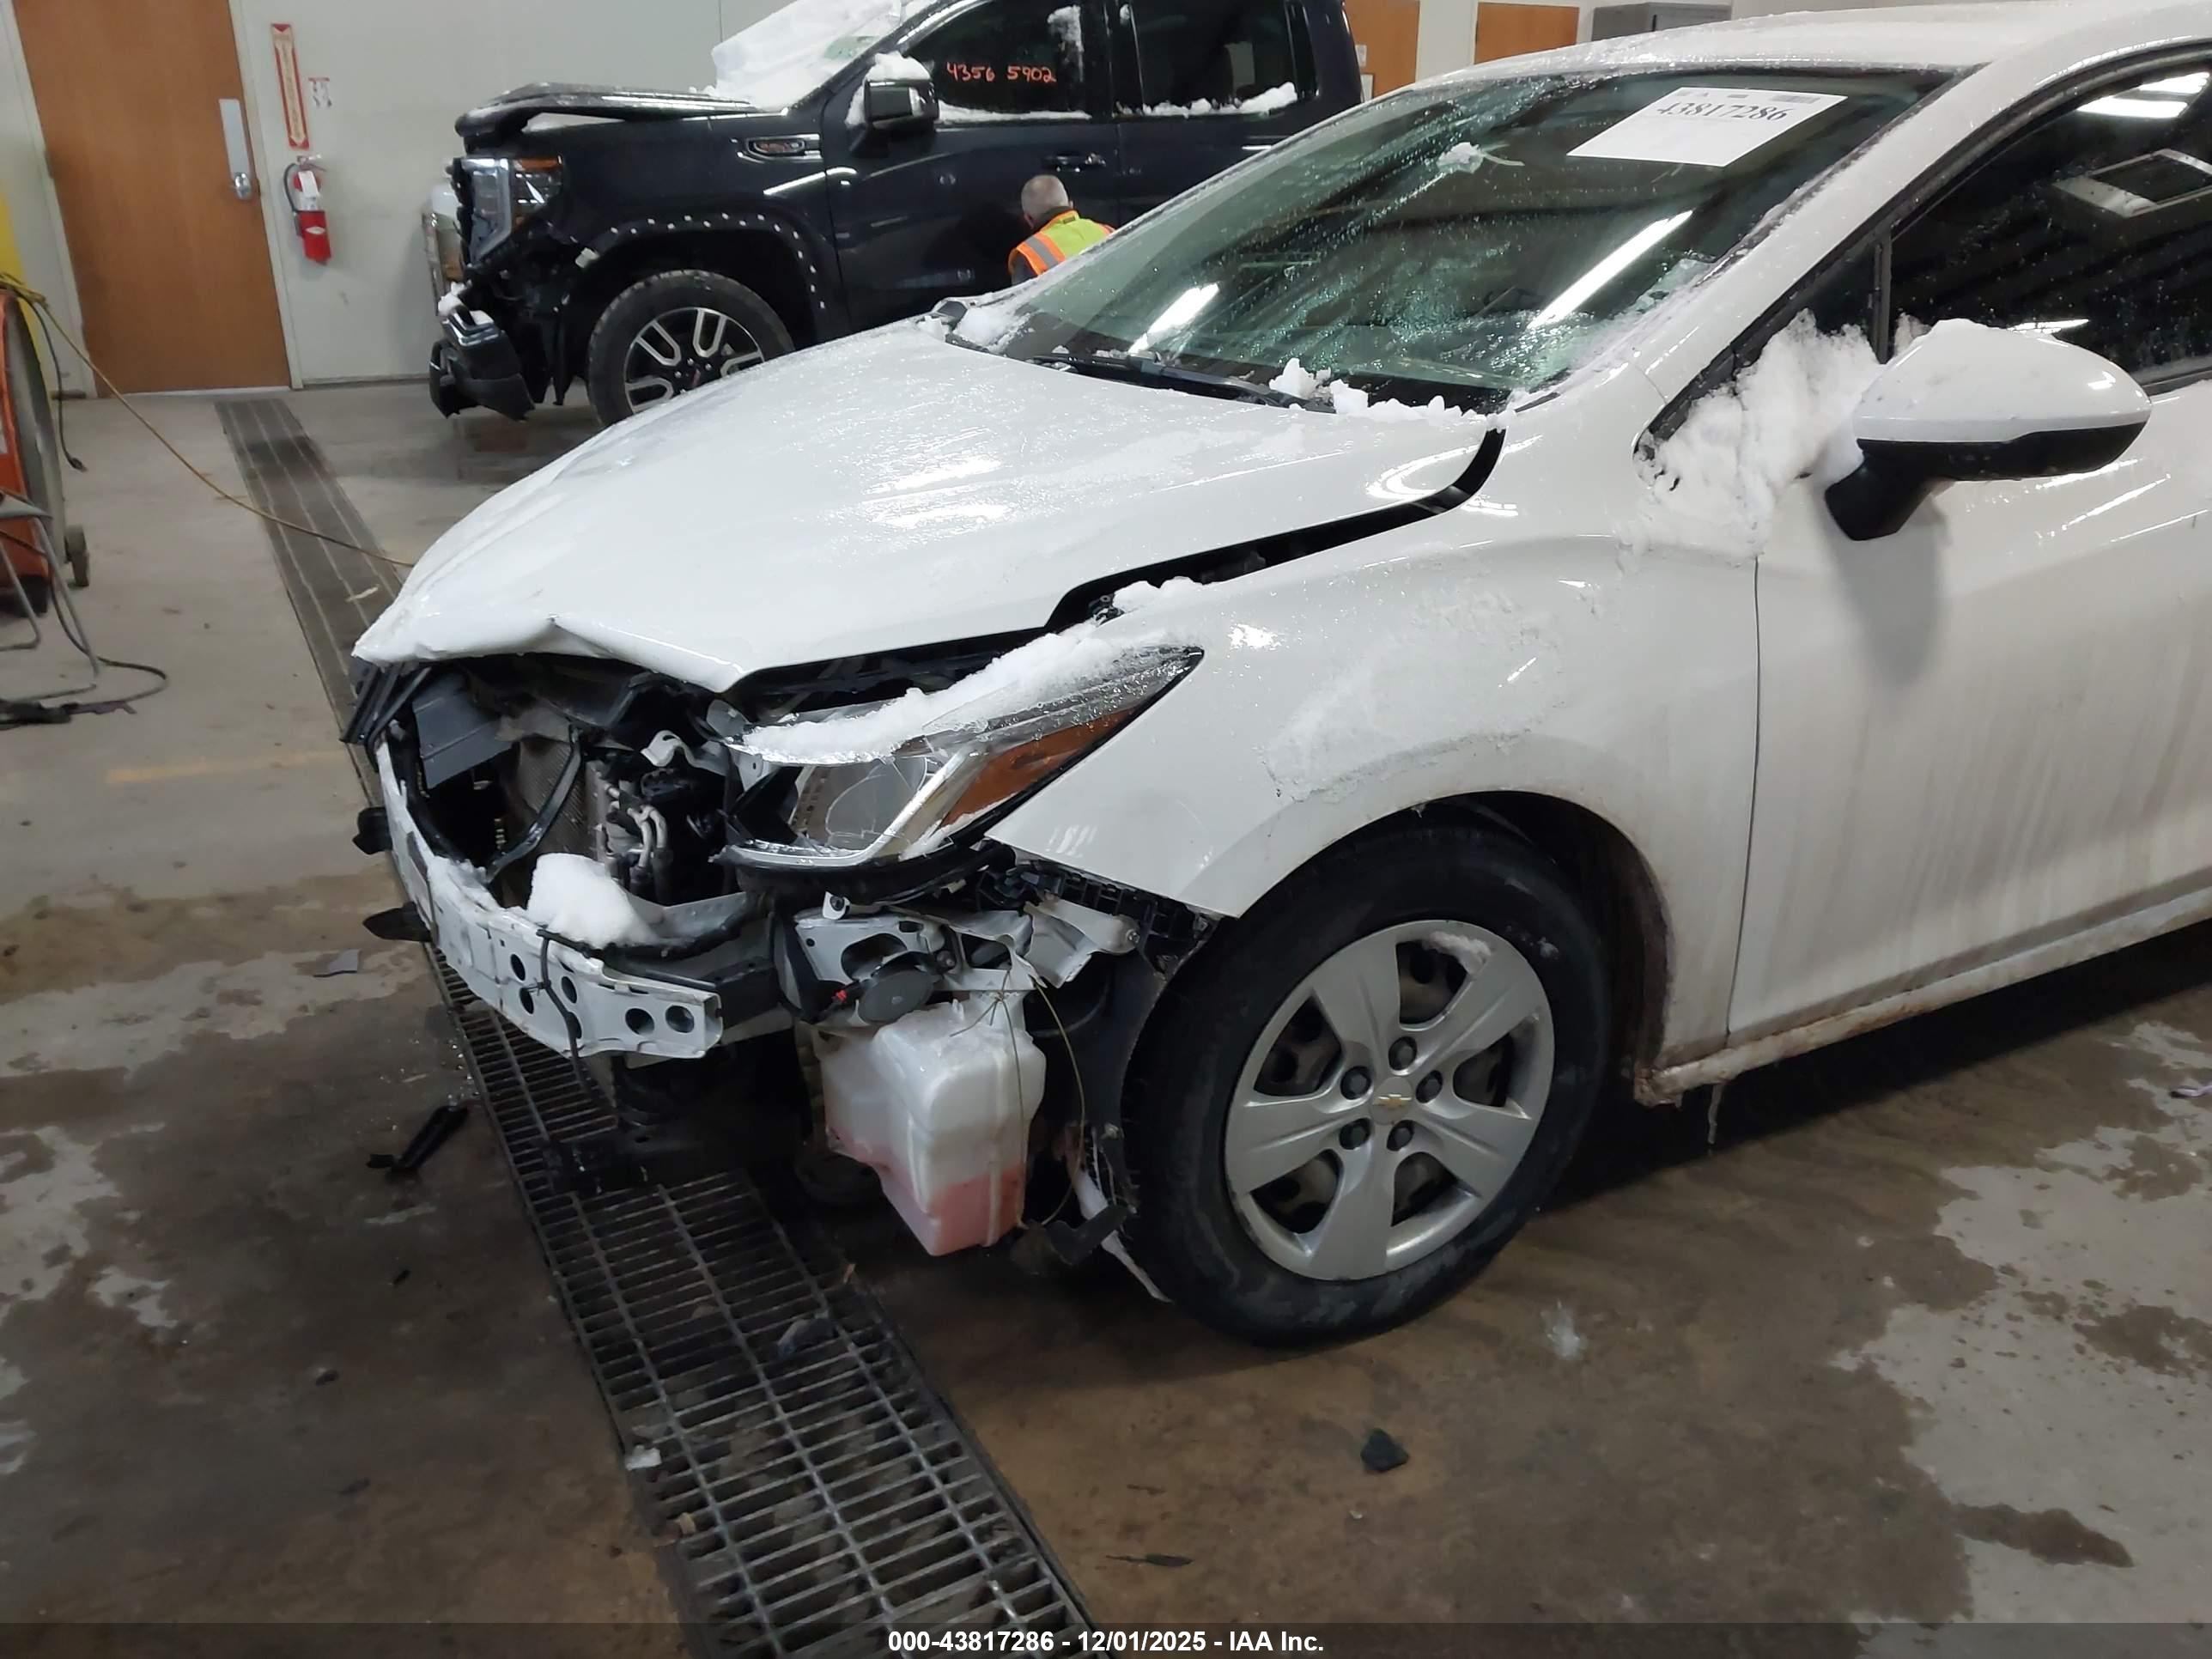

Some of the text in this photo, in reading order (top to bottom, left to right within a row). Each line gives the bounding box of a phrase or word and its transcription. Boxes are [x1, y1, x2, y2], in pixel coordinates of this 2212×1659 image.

[946, 61, 1056, 83] 4356 5902
[1656, 101, 1796, 121] 43817286
